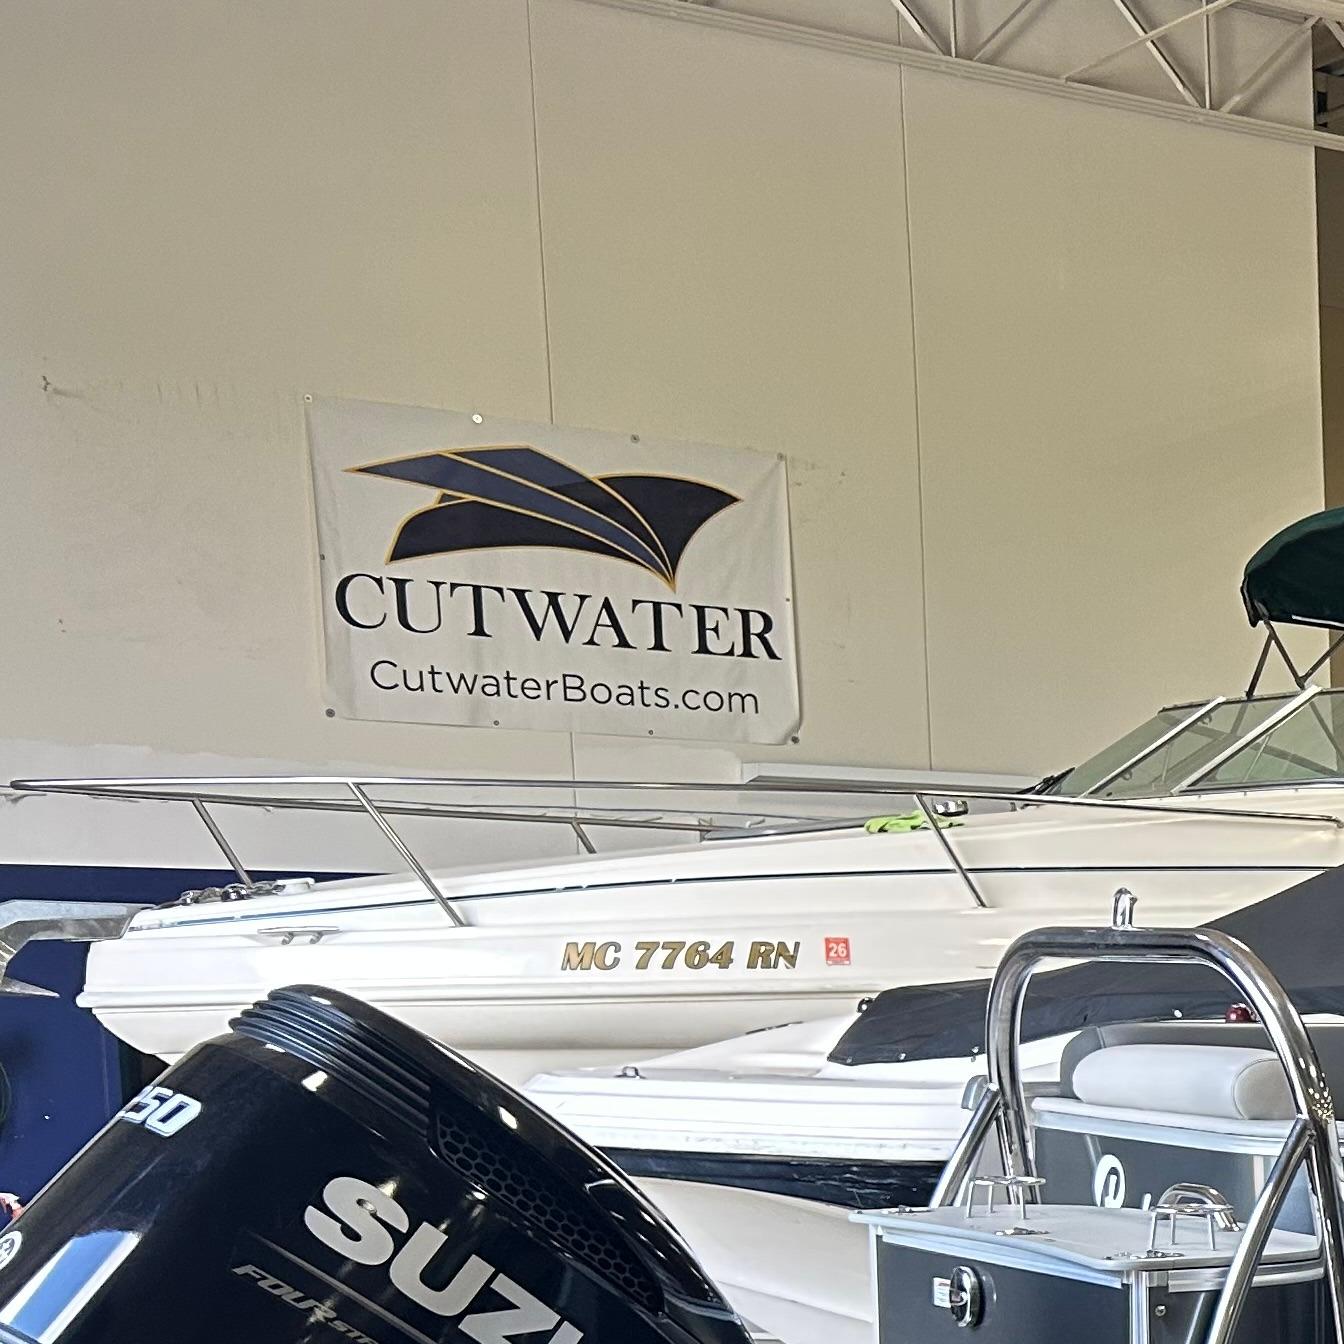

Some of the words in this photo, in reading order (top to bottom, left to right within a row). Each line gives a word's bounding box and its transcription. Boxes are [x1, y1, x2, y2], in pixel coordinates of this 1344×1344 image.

[335, 573, 782, 661] CUTWATER
[370, 660, 759, 714] CutwaterBoats.com
[561, 941, 622, 970] MC
[635, 941, 735, 969] 7764
[746, 941, 801, 969] RN
[828, 942, 848, 958] 26
[117, 1085, 202, 1137] 50
